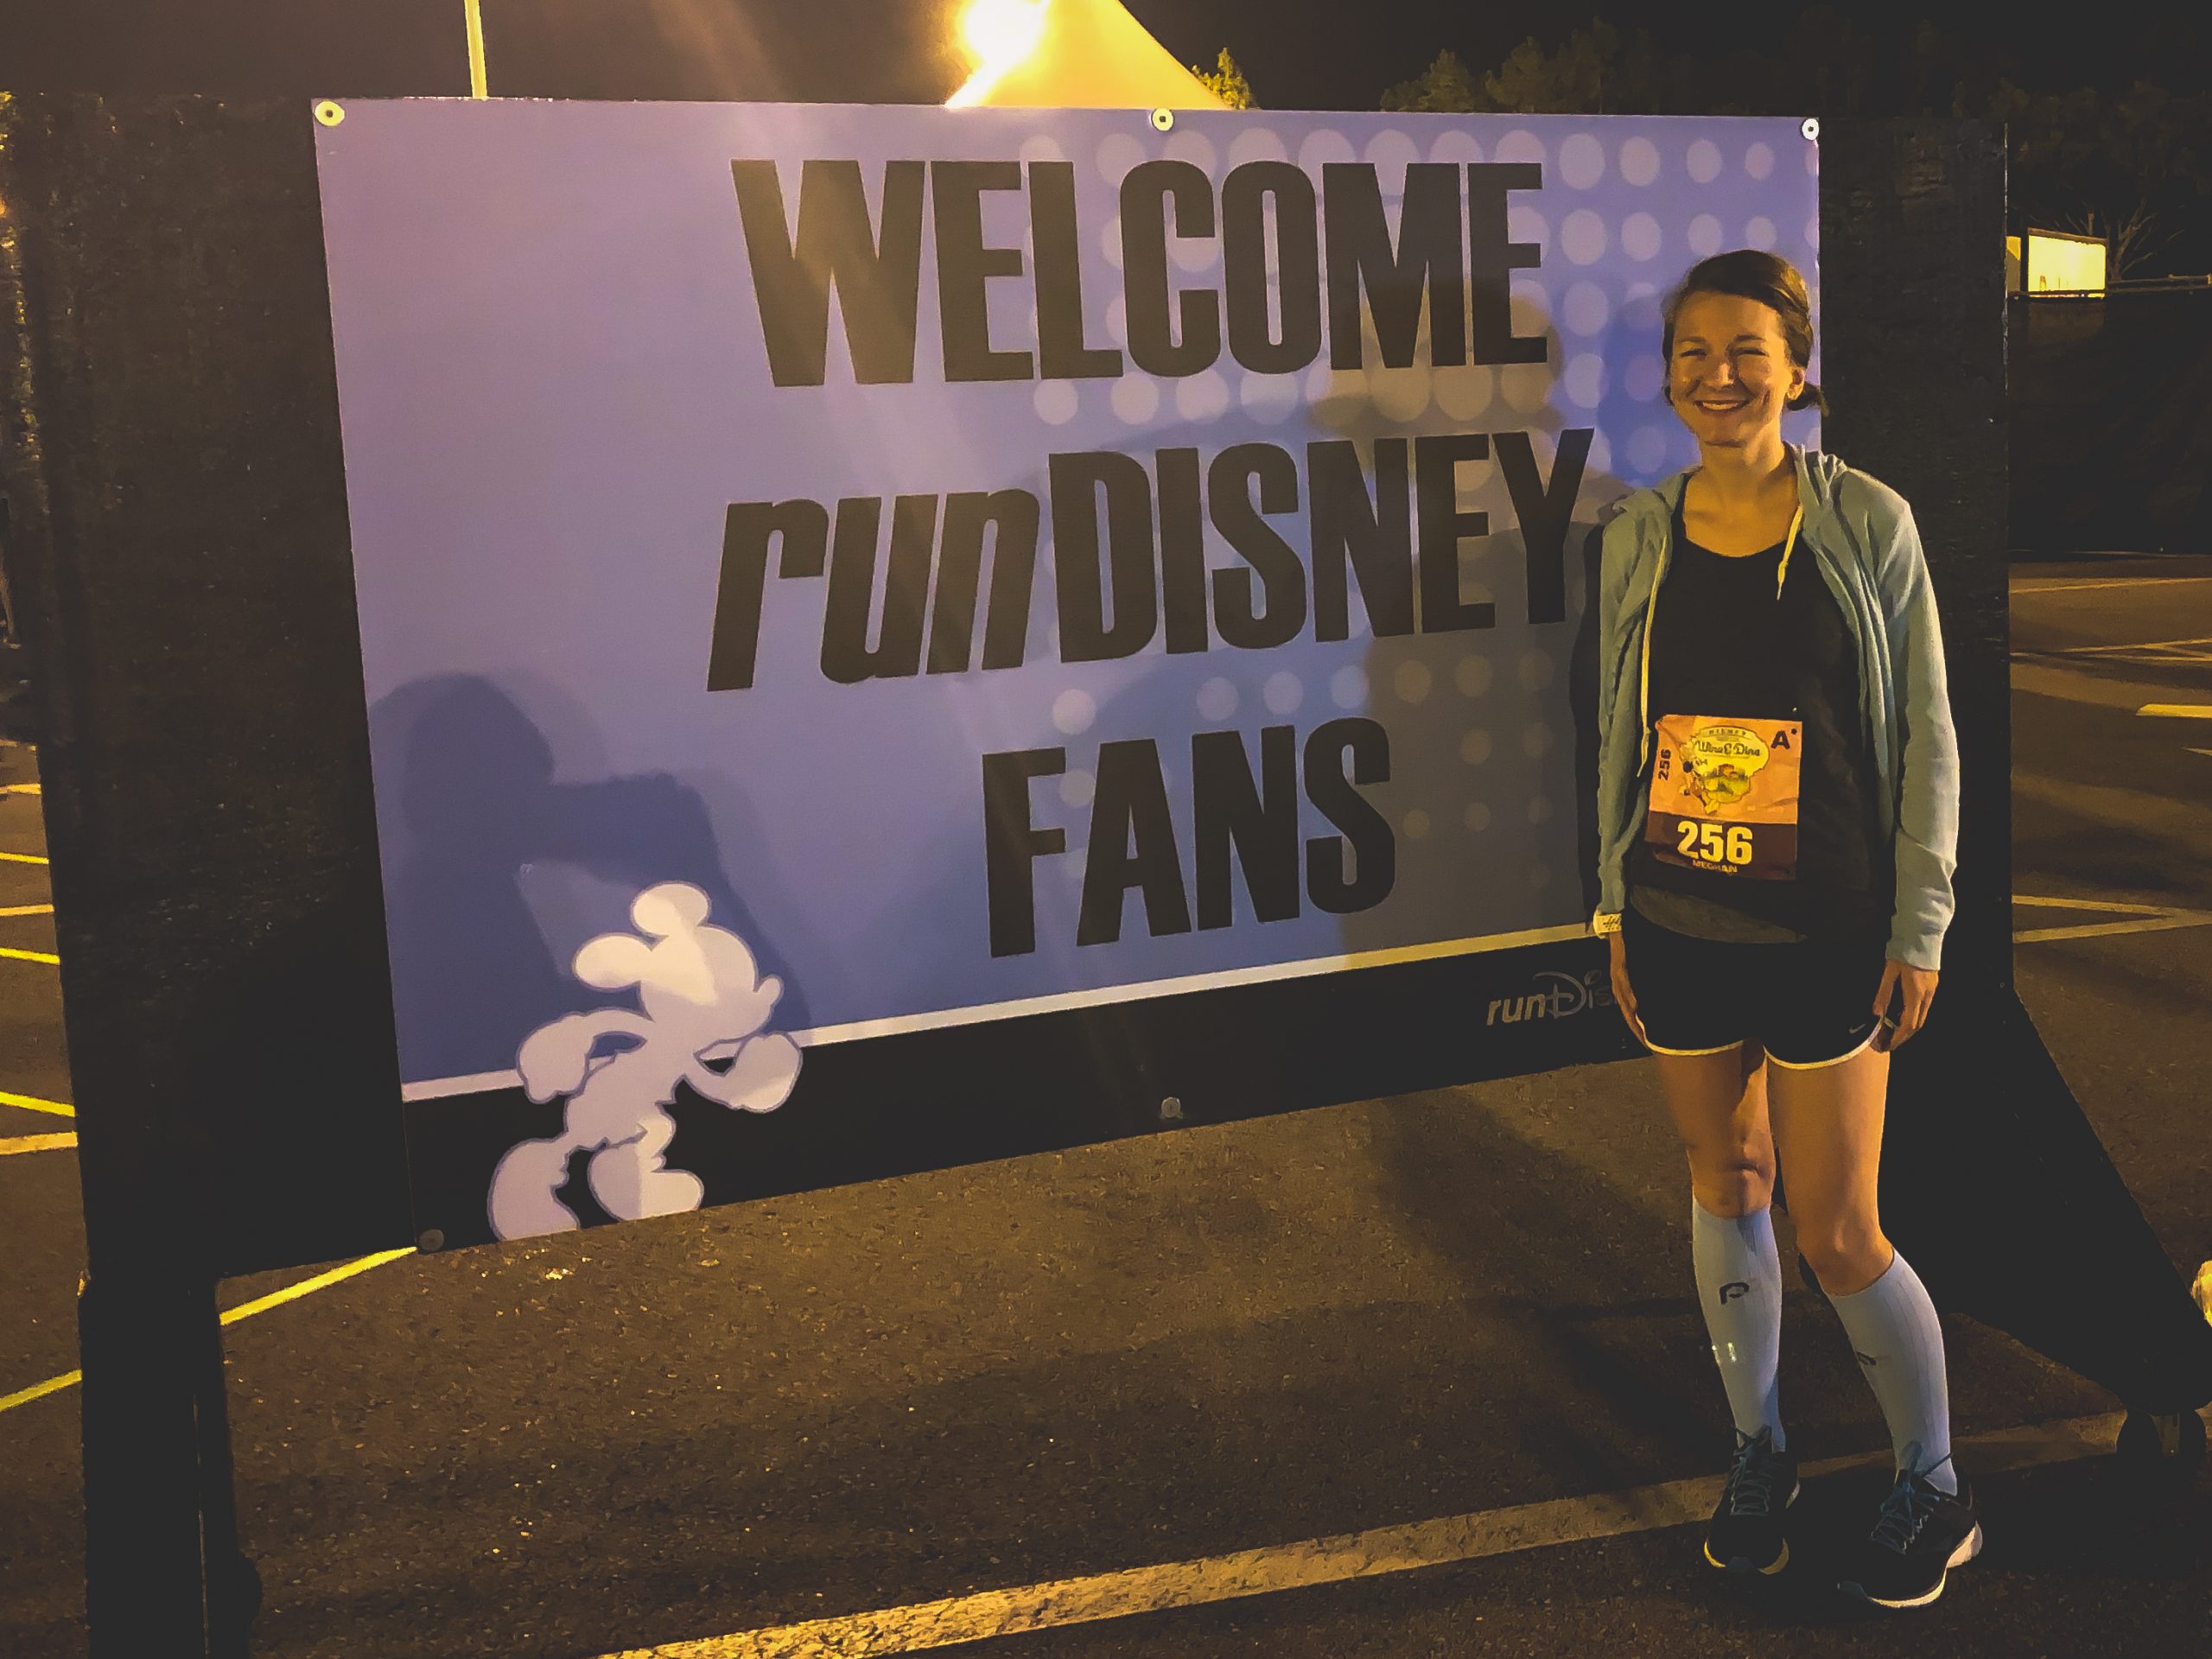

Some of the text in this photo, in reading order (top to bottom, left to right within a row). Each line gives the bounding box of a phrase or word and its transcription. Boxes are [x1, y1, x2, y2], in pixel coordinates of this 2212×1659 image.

[730, 159, 1548, 387] WELCOME
[707, 428, 1595, 692] runDISNEY
[1658, 748, 1671, 781] 256
[982, 717, 1395, 958] FANS
[1677, 820, 1753, 865] 256
[1486, 969, 1616, 1027] runDis
